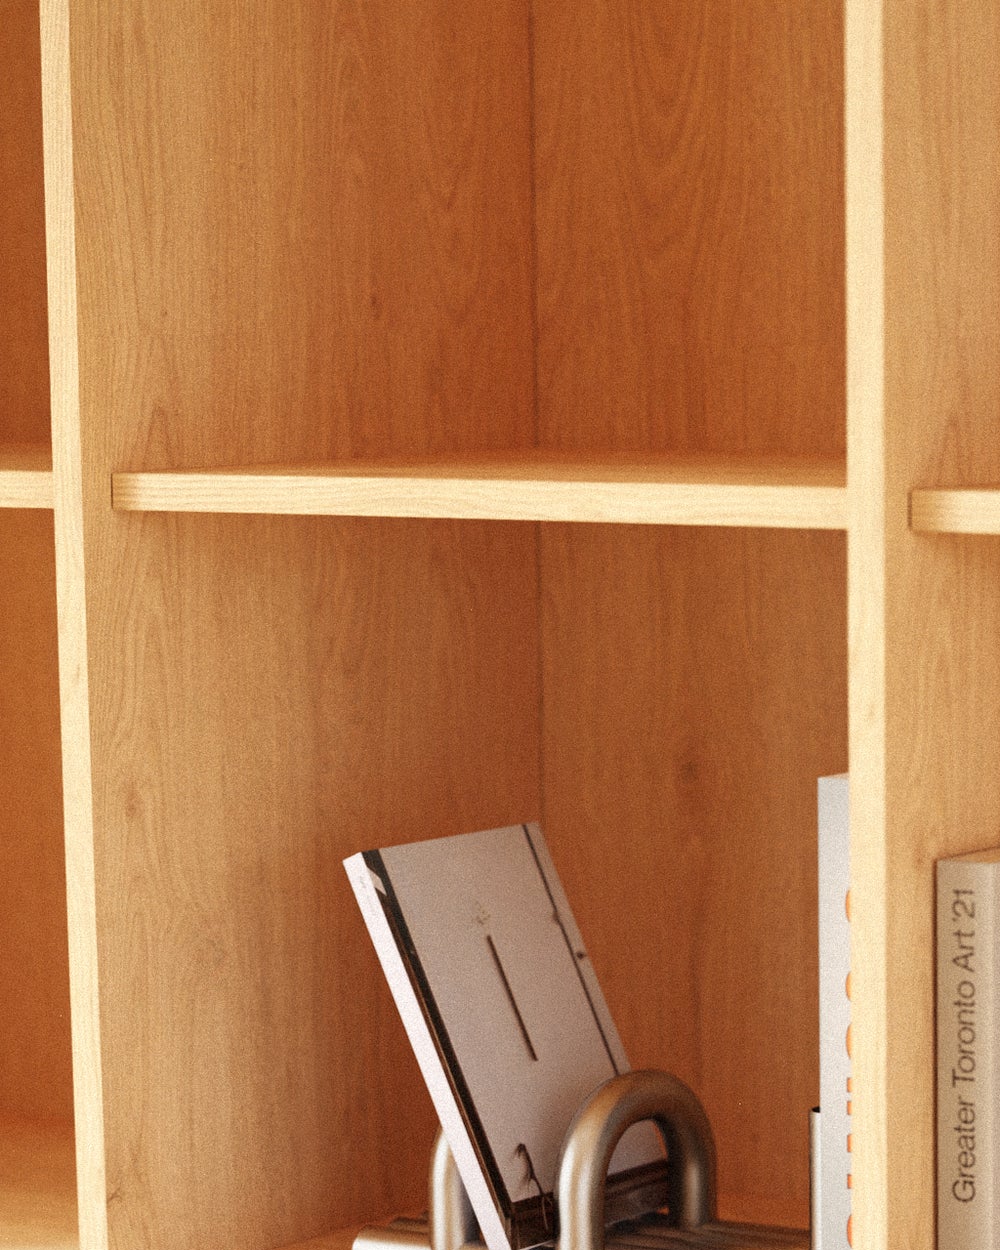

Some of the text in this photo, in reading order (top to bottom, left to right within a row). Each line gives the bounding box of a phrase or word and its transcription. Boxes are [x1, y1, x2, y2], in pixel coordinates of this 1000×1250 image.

[952, 889, 976, 1203] Greater Toronto Art '21
